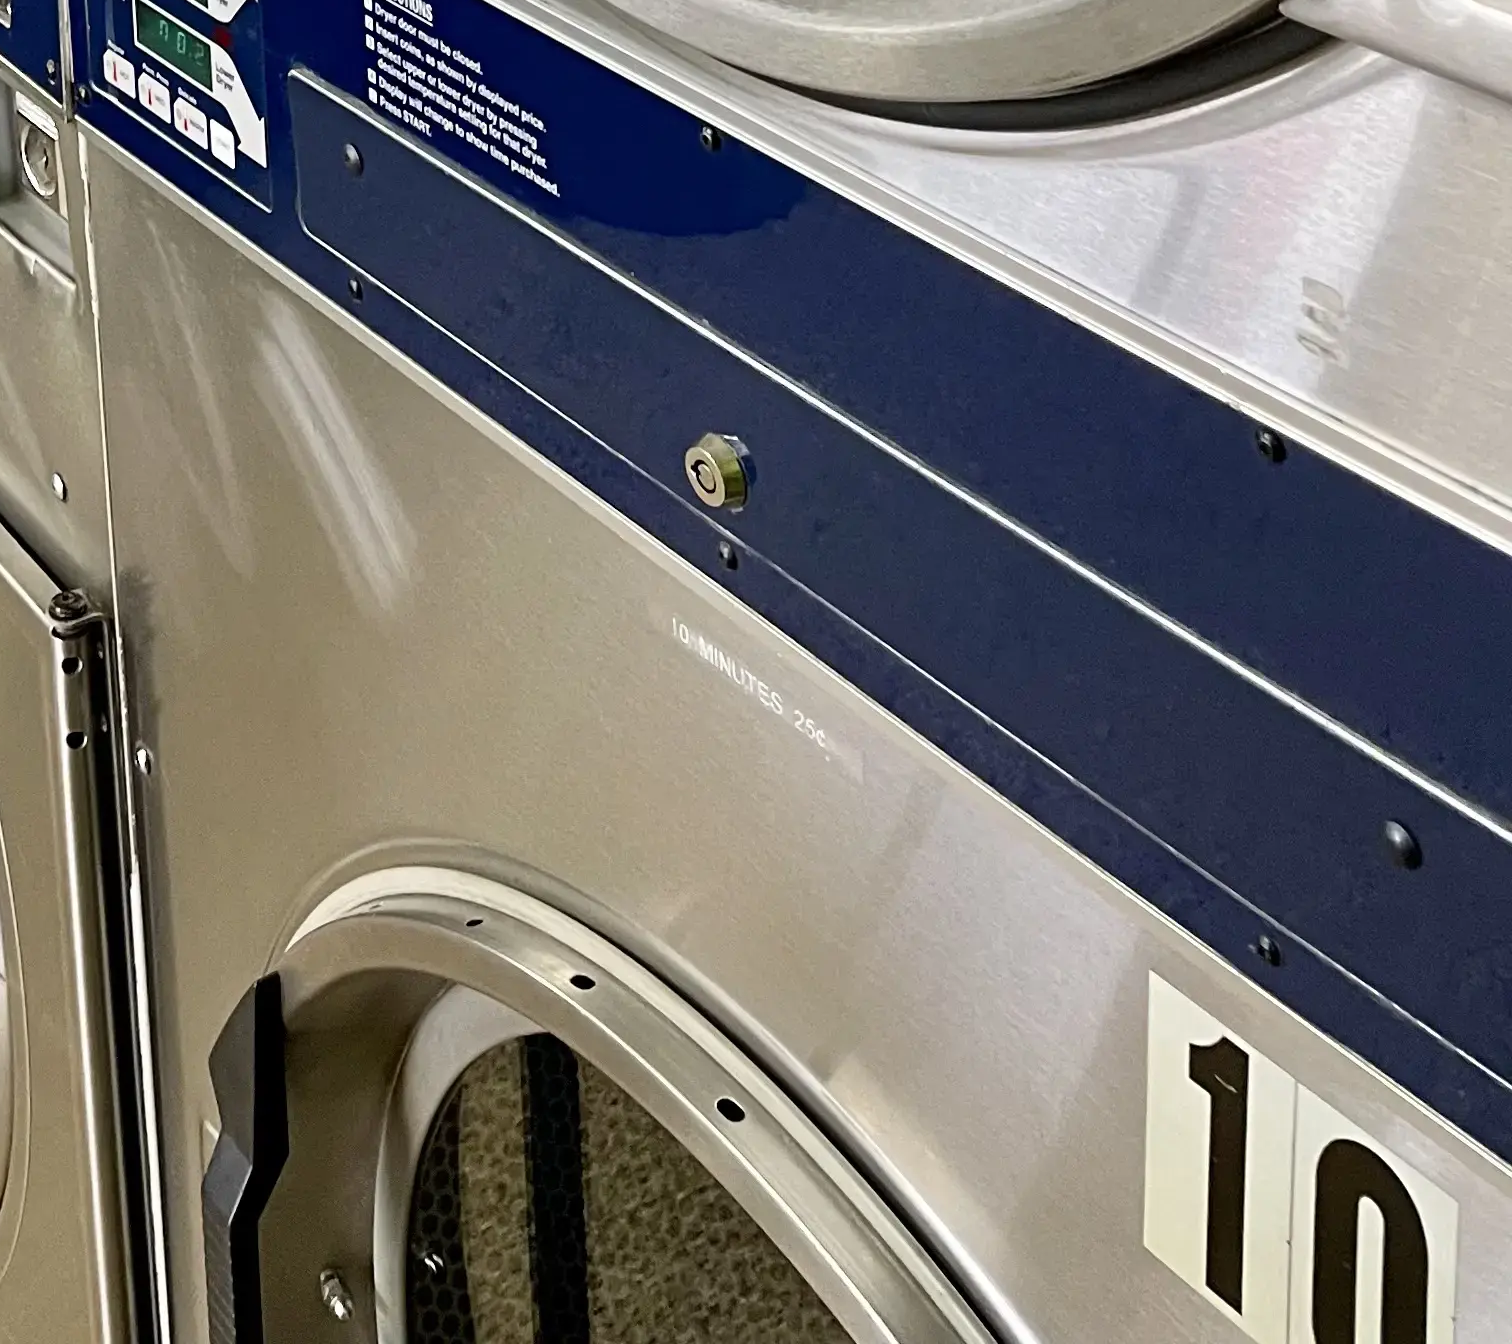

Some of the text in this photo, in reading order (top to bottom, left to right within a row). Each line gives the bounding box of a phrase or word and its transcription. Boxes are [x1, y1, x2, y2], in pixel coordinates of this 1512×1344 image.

[374, 2, 398, 25] Dryer
[397, 17, 417, 36] door
[439, 40, 451, 57] be
[465, 75, 477, 93] by
[455, 123, 465, 139] to
[486, 107, 498, 126] by
[672, 617, 689, 644] 10
[698, 635, 784, 715] MINUTES
[1188, 1036, 1429, 1344] 10
